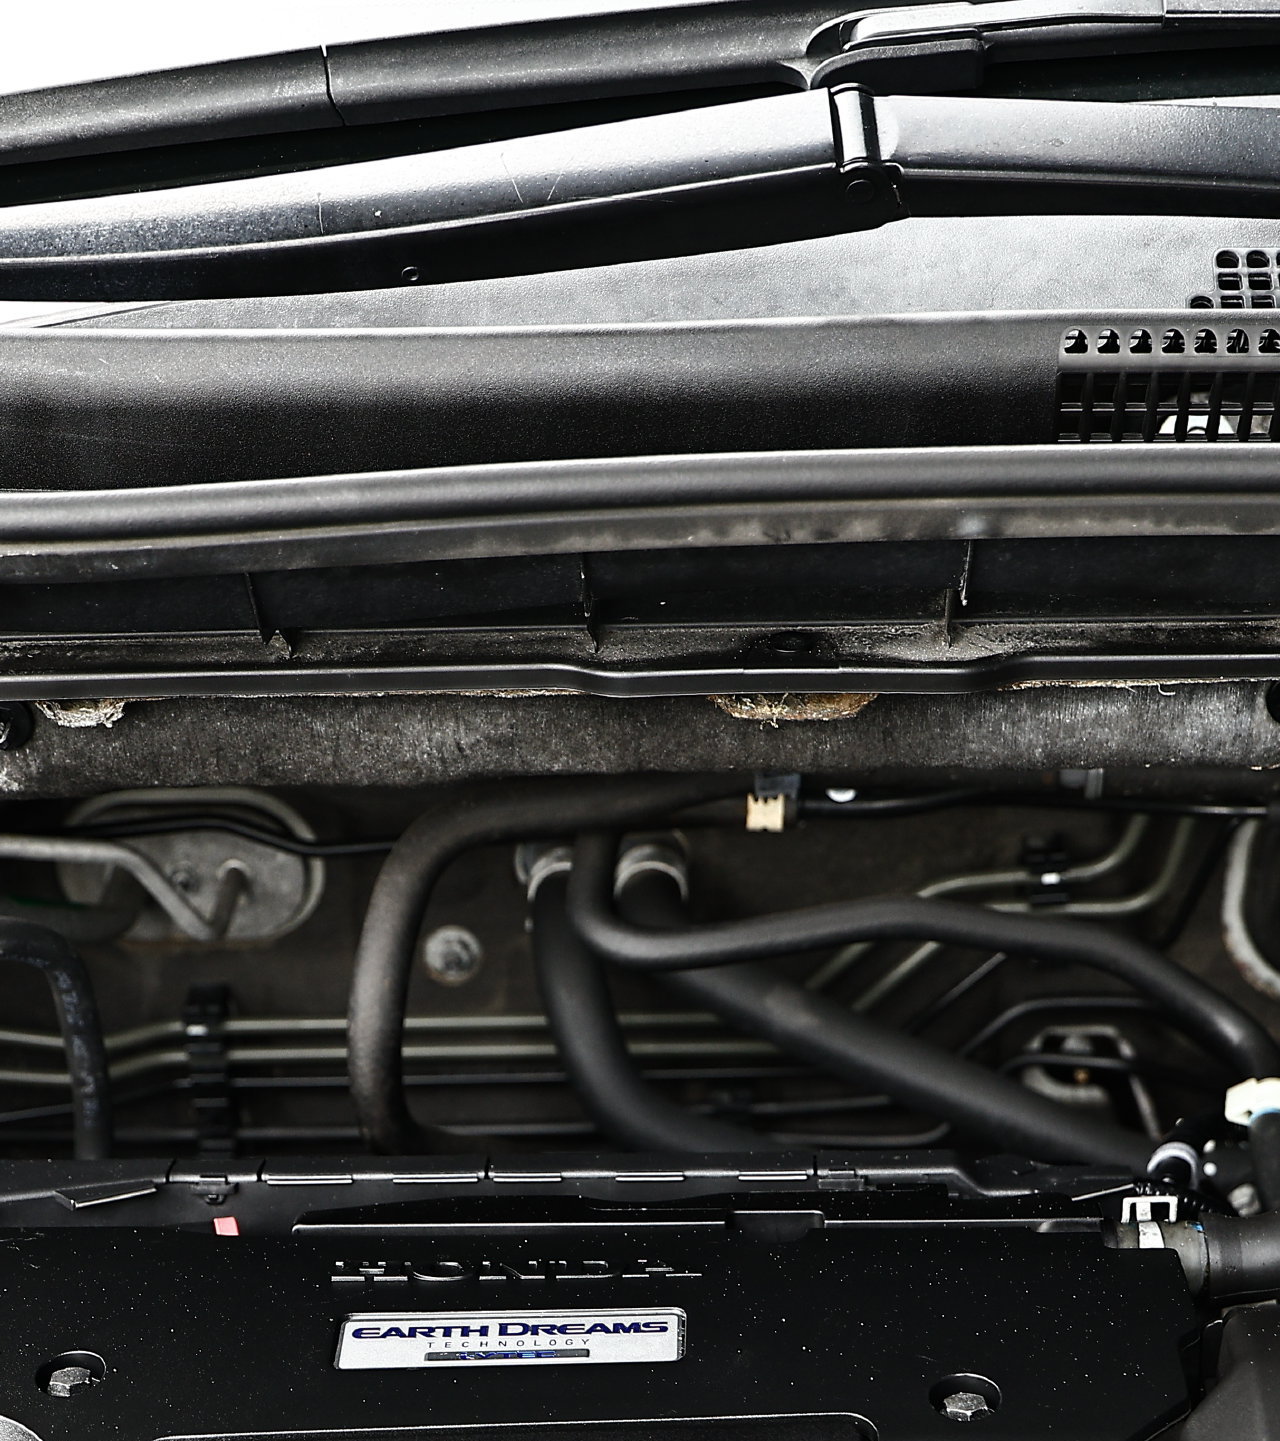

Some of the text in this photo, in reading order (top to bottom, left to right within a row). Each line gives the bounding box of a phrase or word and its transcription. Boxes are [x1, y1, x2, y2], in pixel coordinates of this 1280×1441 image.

[331, 1260, 702, 1282] HONDA
[351, 1320, 669, 1340] EARTH DREAMS
[427, 1338, 591, 1349] TECHNOLOGY
